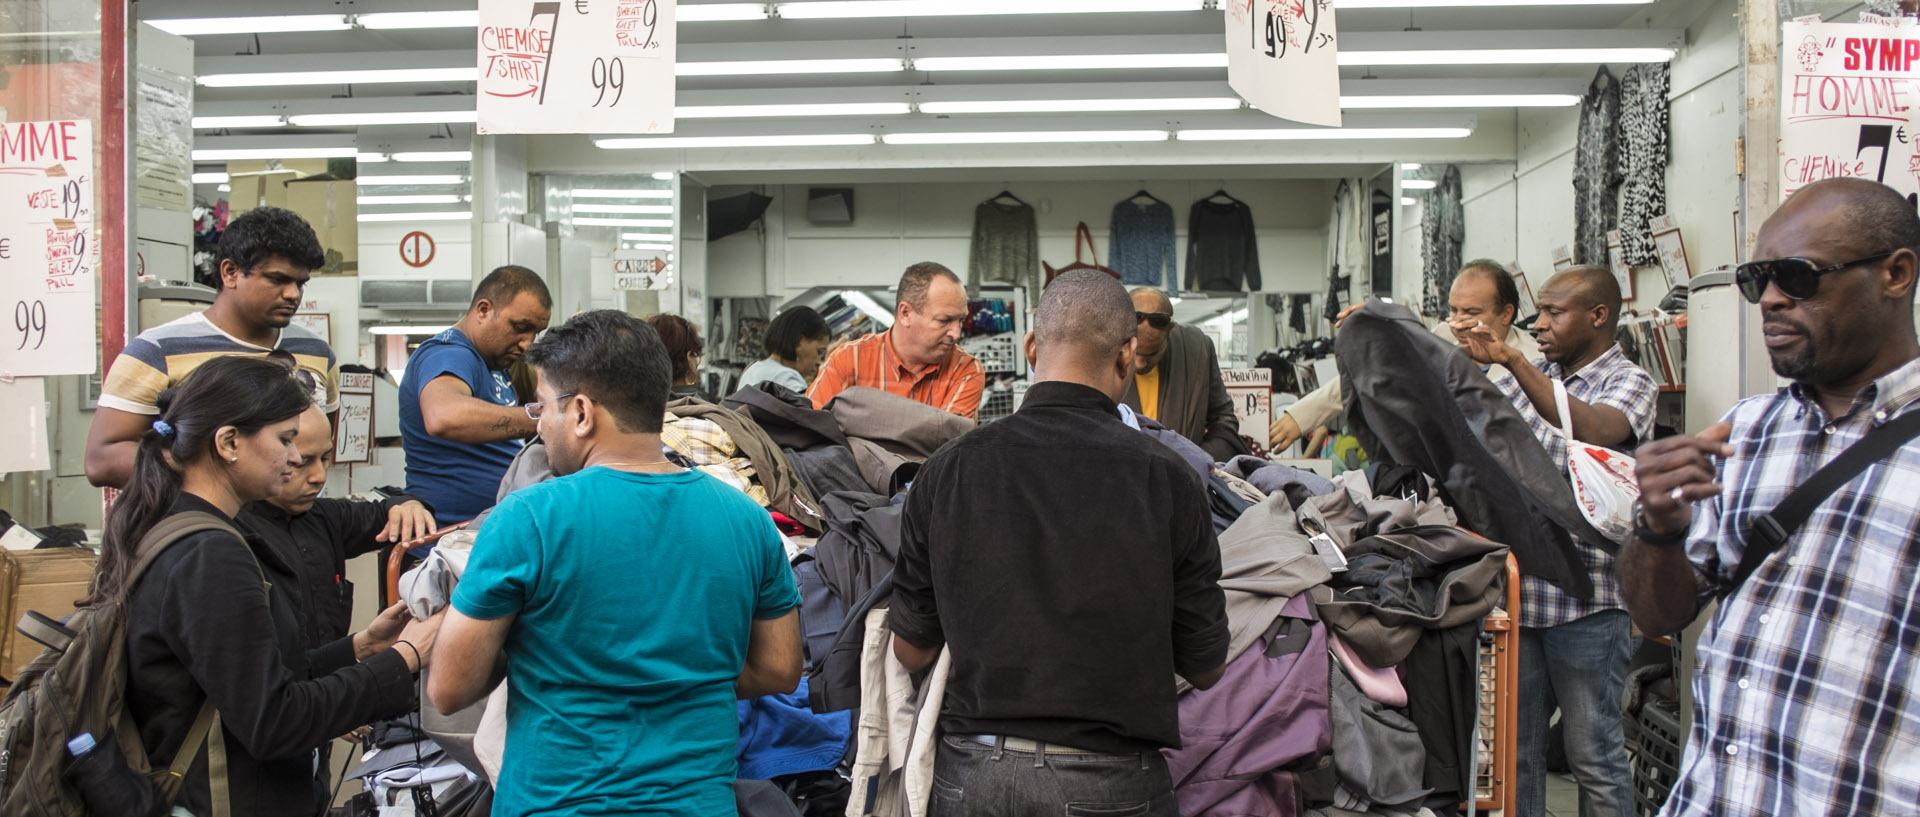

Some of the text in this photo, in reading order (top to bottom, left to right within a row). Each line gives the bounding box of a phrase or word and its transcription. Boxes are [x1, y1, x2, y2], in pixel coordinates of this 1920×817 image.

[616, 6, 642, 17] SWEAT
[616, 20, 638, 30] GILET
[529, 2, 561, 105] 7
[592, 57, 624, 107] 99
[1792, 77, 1909, 116] HOMME
[0, 122, 78, 164] MME
[1896, 125, 1908, 143] €
[27, 189, 59, 209] VESTE
[62, 179, 80, 219] 19
[614, 259, 656, 273] CAISSE
[15, 300, 46, 350] 99
